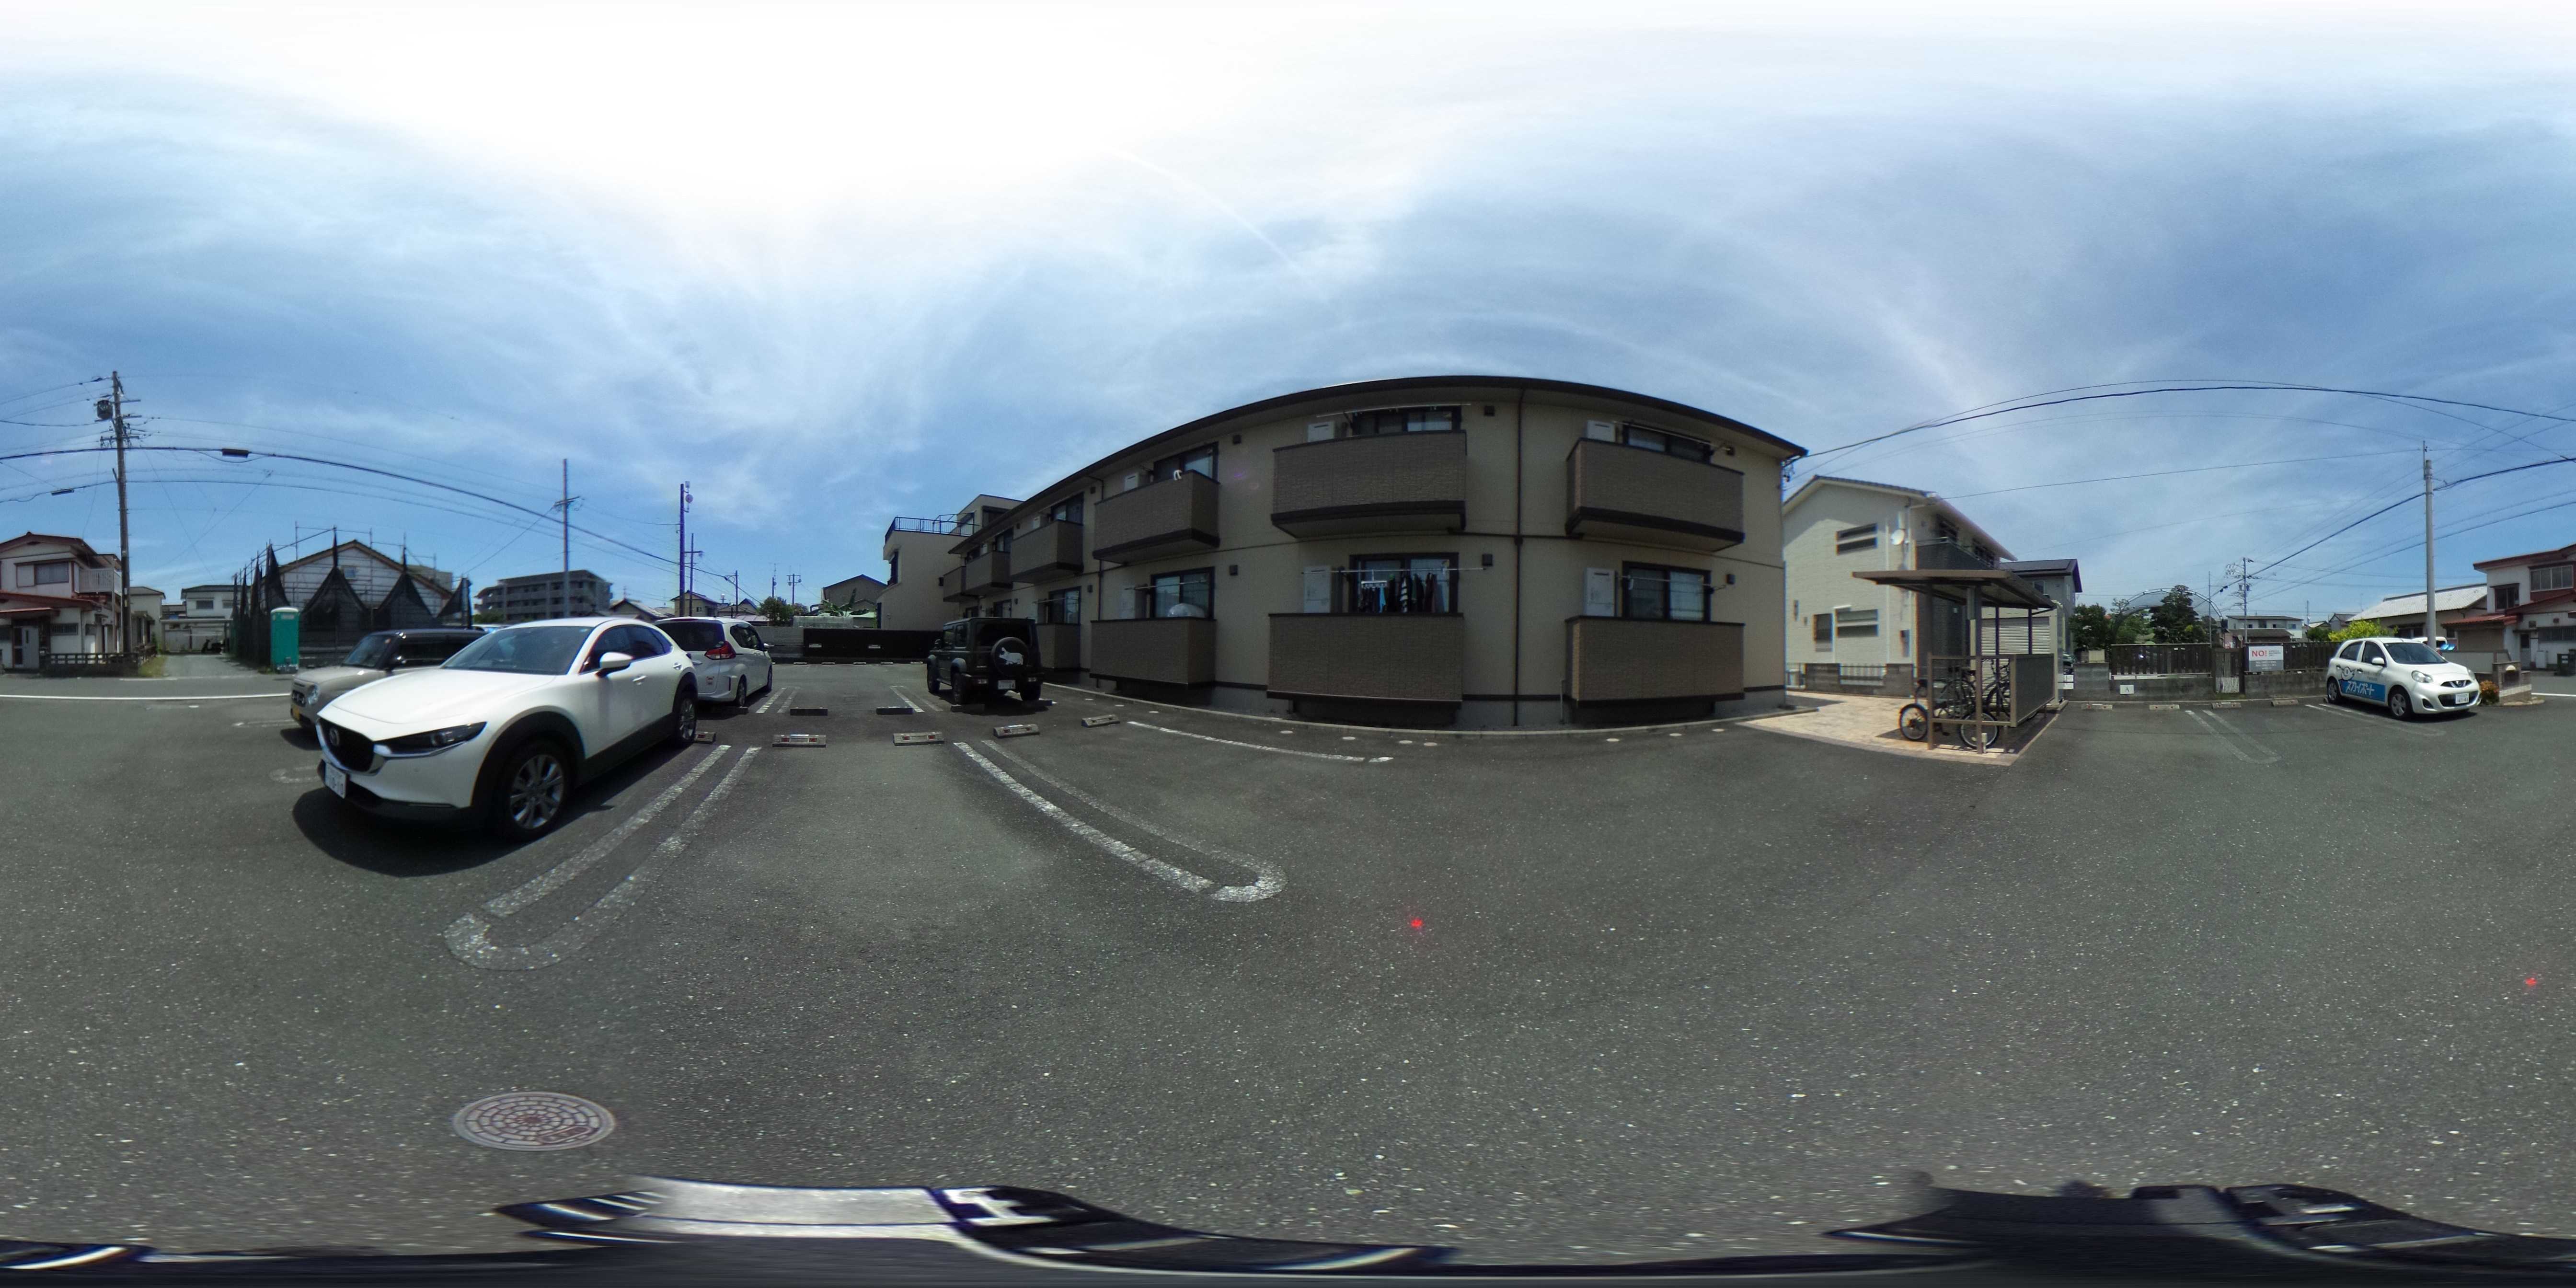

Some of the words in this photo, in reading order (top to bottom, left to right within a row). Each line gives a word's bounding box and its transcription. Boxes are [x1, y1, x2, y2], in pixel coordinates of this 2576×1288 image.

[2346, 681, 2375, 696] スカイポート
